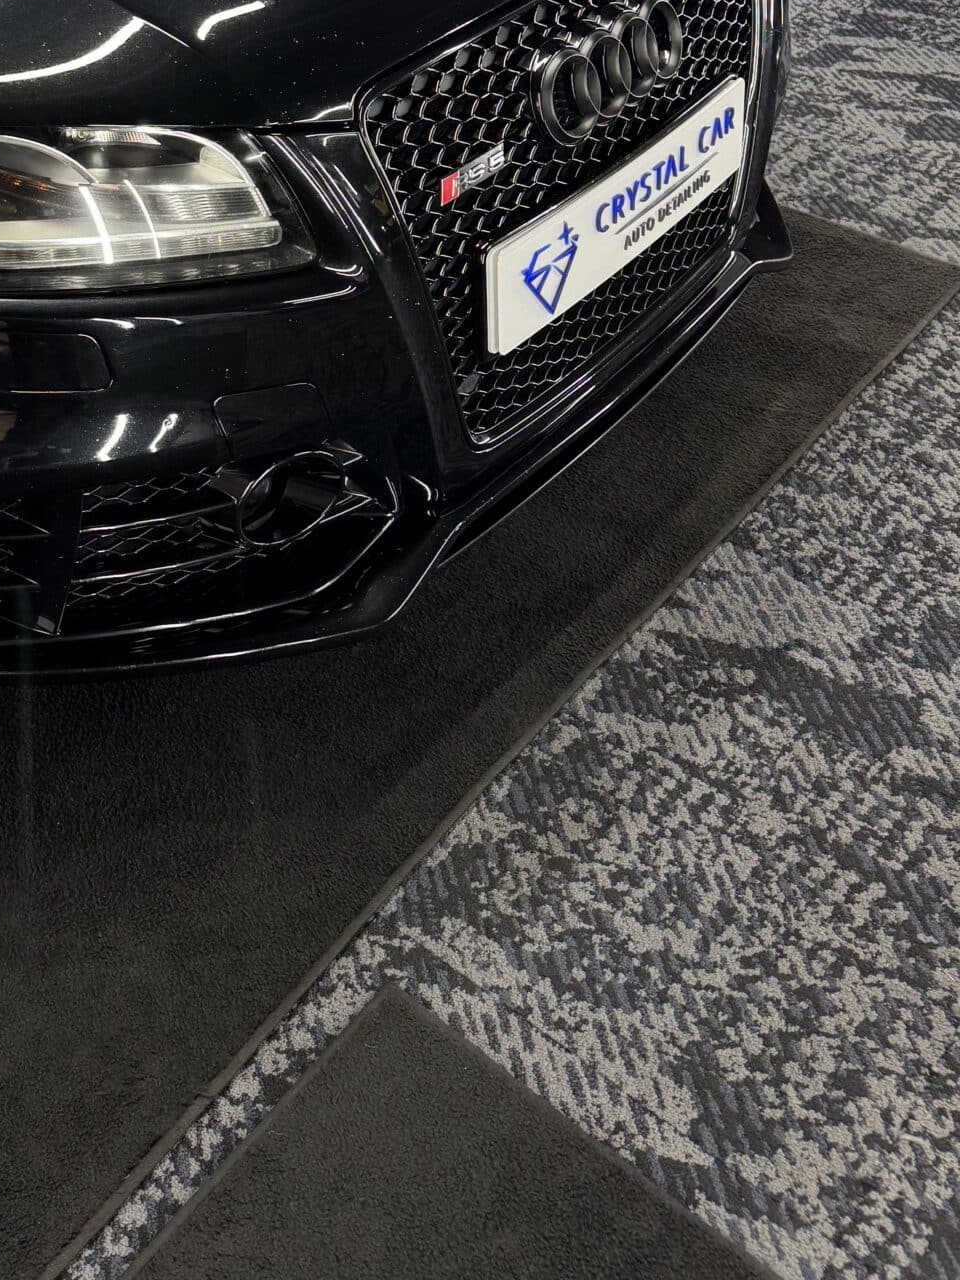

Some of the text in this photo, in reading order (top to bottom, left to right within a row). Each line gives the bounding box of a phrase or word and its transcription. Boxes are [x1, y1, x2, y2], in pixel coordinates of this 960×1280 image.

[595, 107, 736, 233] CRYSTAL CAR
[623, 170, 711, 251] AUTO DETAILING
